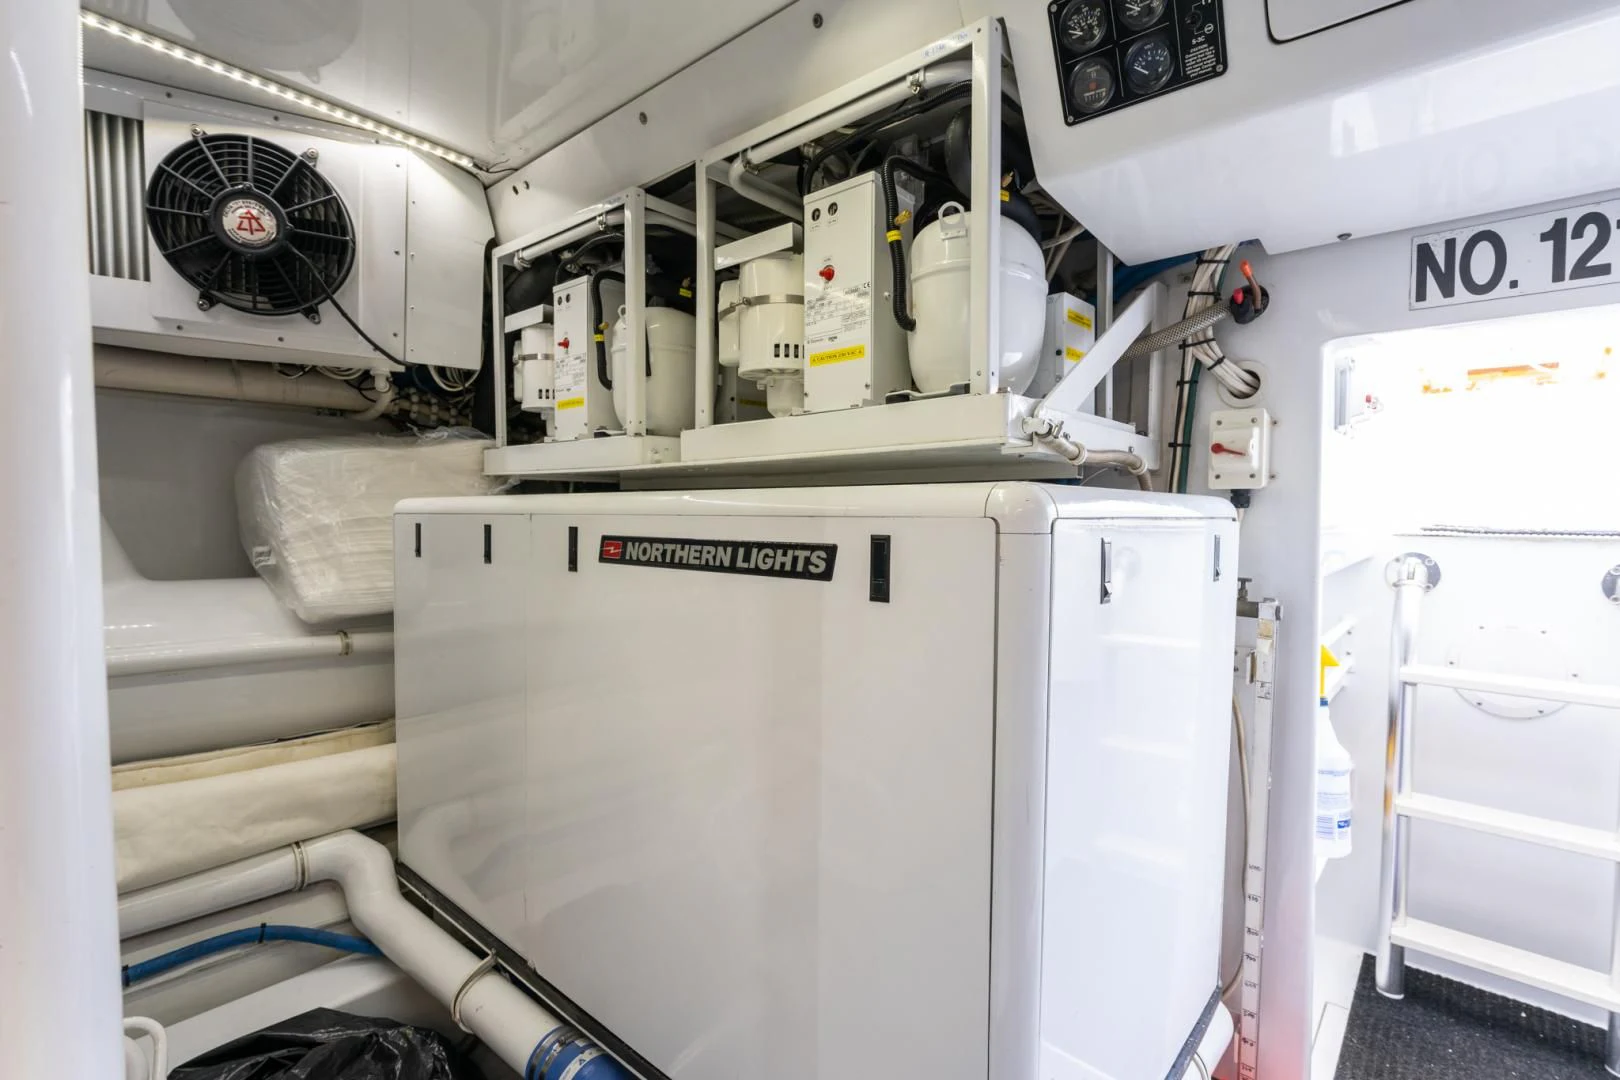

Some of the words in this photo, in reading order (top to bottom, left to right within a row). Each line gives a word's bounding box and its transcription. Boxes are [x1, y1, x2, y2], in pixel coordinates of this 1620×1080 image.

[1415, 229, 1519, 303] NO.
[1540, 211, 1620, 283] 12
[625, 541, 732, 567] NORTHERN
[736, 546, 828, 574] LIGHTS
